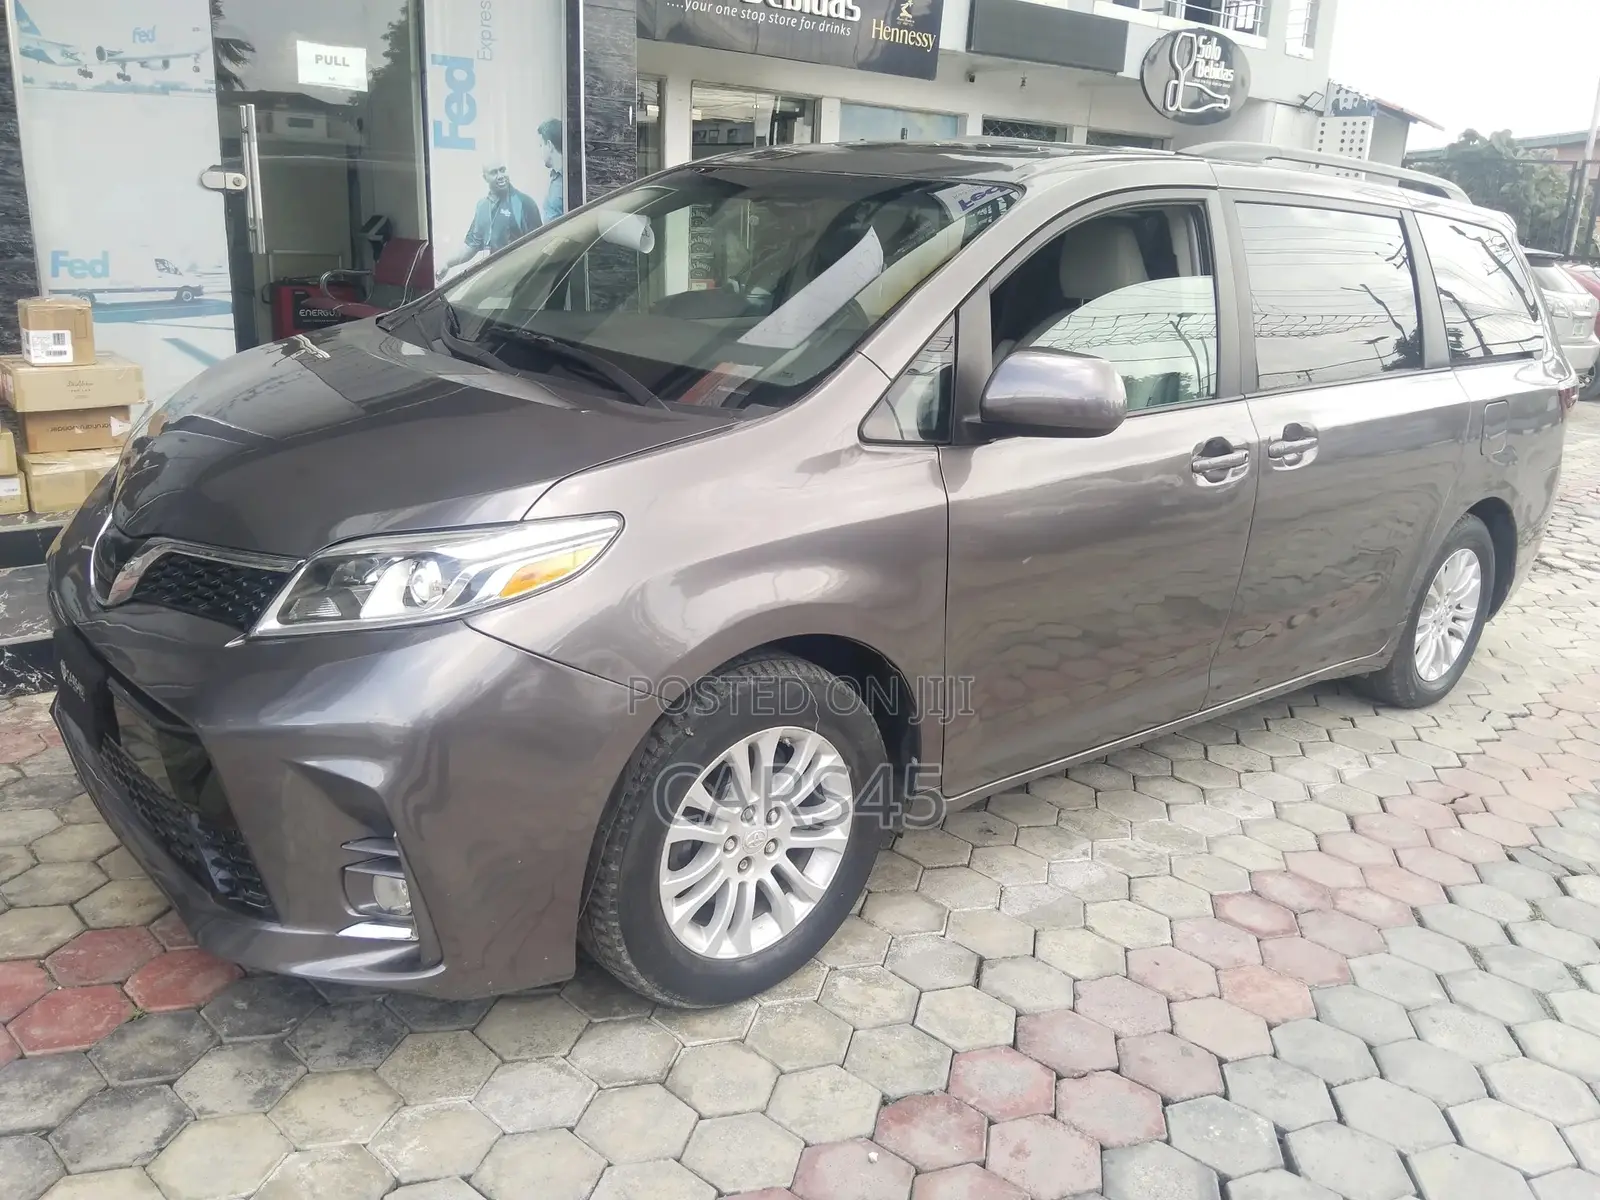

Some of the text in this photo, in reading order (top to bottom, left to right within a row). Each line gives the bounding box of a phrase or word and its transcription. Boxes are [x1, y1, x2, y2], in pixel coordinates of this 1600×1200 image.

[715, 4, 738, 18] one
[740, 7, 766, 23] stop
[768, 12, 798, 28] store
[798, 16, 816, 31] for
[818, 20, 852, 37] drinks
[871, 18, 937, 52] Hennessy
[314, 53, 350, 68] PULL
[1194, 58, 1235, 82] Bebidas
[431, 53, 477, 151] Fed
[50, 250, 110, 279] Fed
